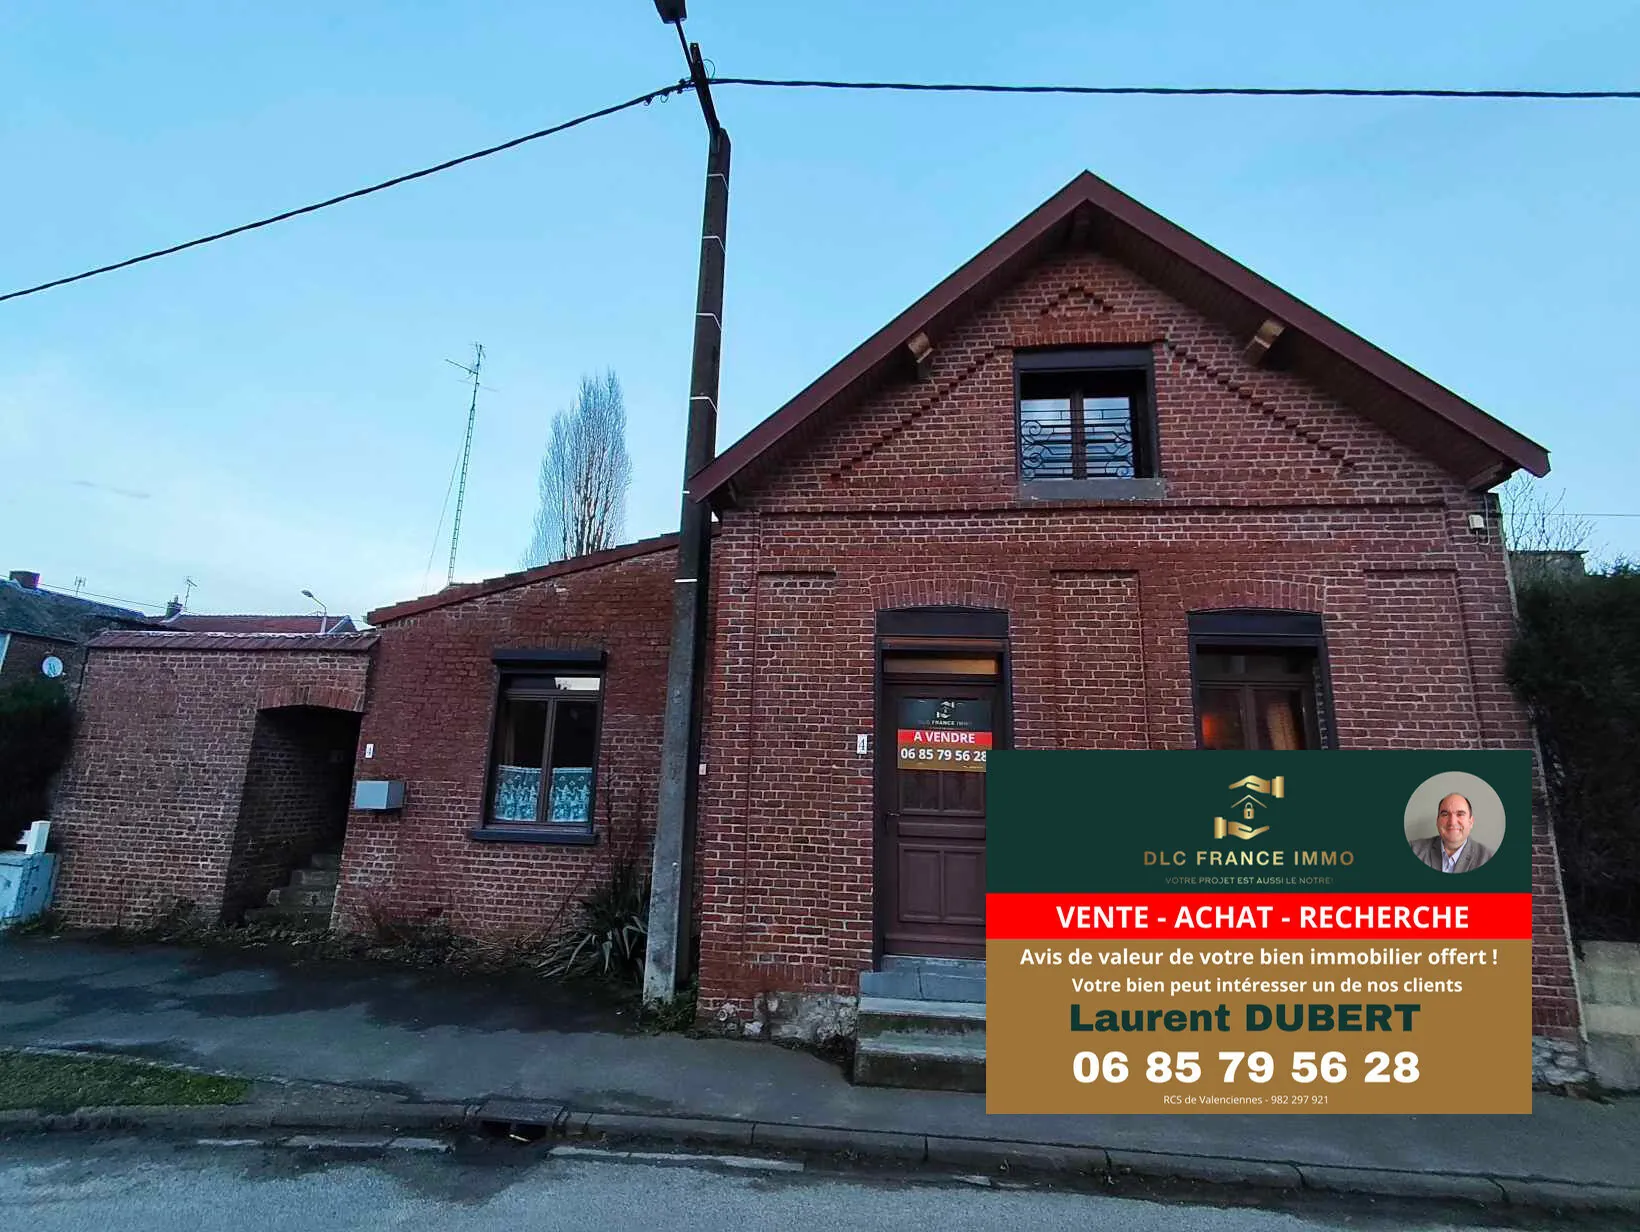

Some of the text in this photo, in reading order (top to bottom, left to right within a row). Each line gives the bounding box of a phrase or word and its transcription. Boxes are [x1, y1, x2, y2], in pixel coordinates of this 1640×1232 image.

[858, 735, 866, 752] 4
[914, 731, 976, 743] A VENDRE
[900, 748, 986, 762] 06 85 79 56 28
